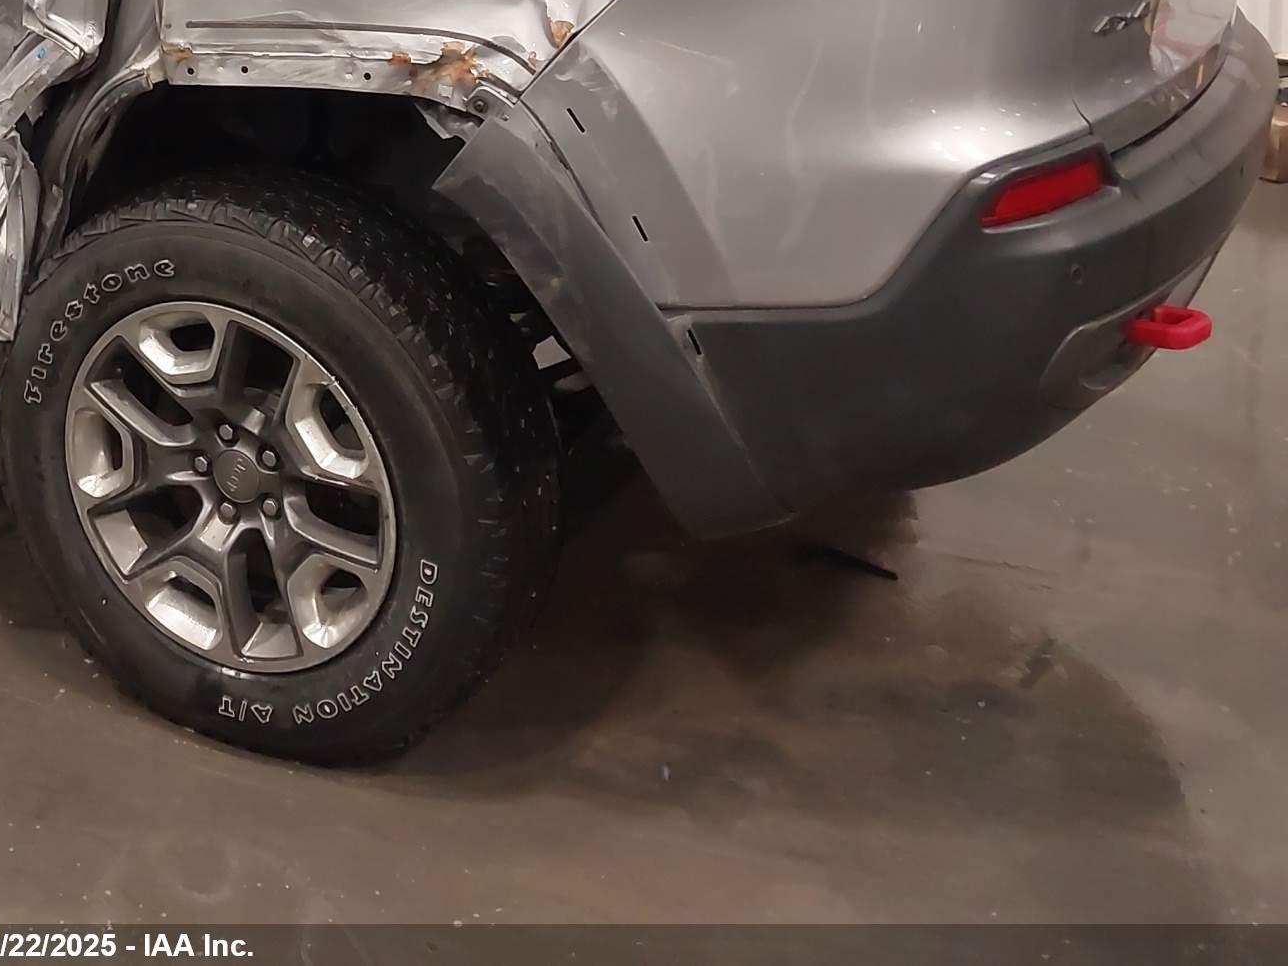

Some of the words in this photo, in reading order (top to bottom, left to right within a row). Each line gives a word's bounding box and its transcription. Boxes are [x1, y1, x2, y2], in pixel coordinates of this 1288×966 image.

[23, 259, 176, 404] Firestone
[218, 694, 274, 724] A/T
[292, 558, 439, 724] DESTINATION
